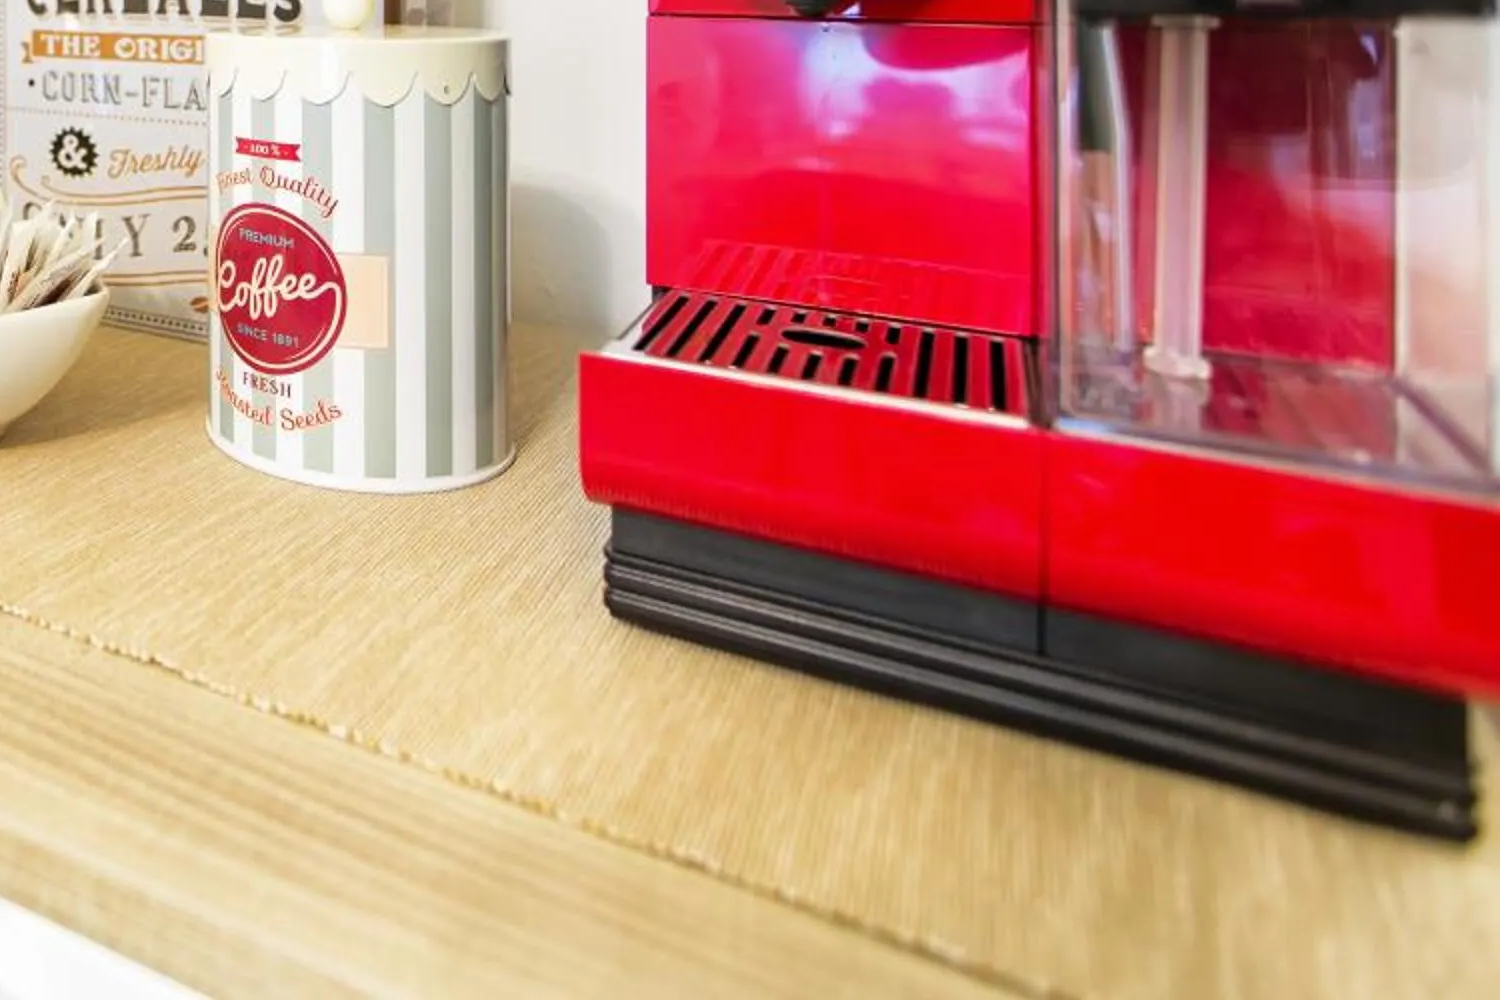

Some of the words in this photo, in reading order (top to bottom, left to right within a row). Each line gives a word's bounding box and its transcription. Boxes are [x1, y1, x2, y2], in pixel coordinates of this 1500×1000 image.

[40, 33, 100, 57] THE
[114, 37, 204, 62] ORIGI
[42, 70, 210, 111] CORN-FLA
[107, 144, 204, 179] Freshly
[259, 165, 339, 219] Quality
[239, 227, 295, 249] PREMIUM
[218, 253, 330, 320] Coffee
[236, 322, 268, 341] SINCE
[243, 371, 293, 398] FRESH
[280, 399, 342, 431] Seeds
